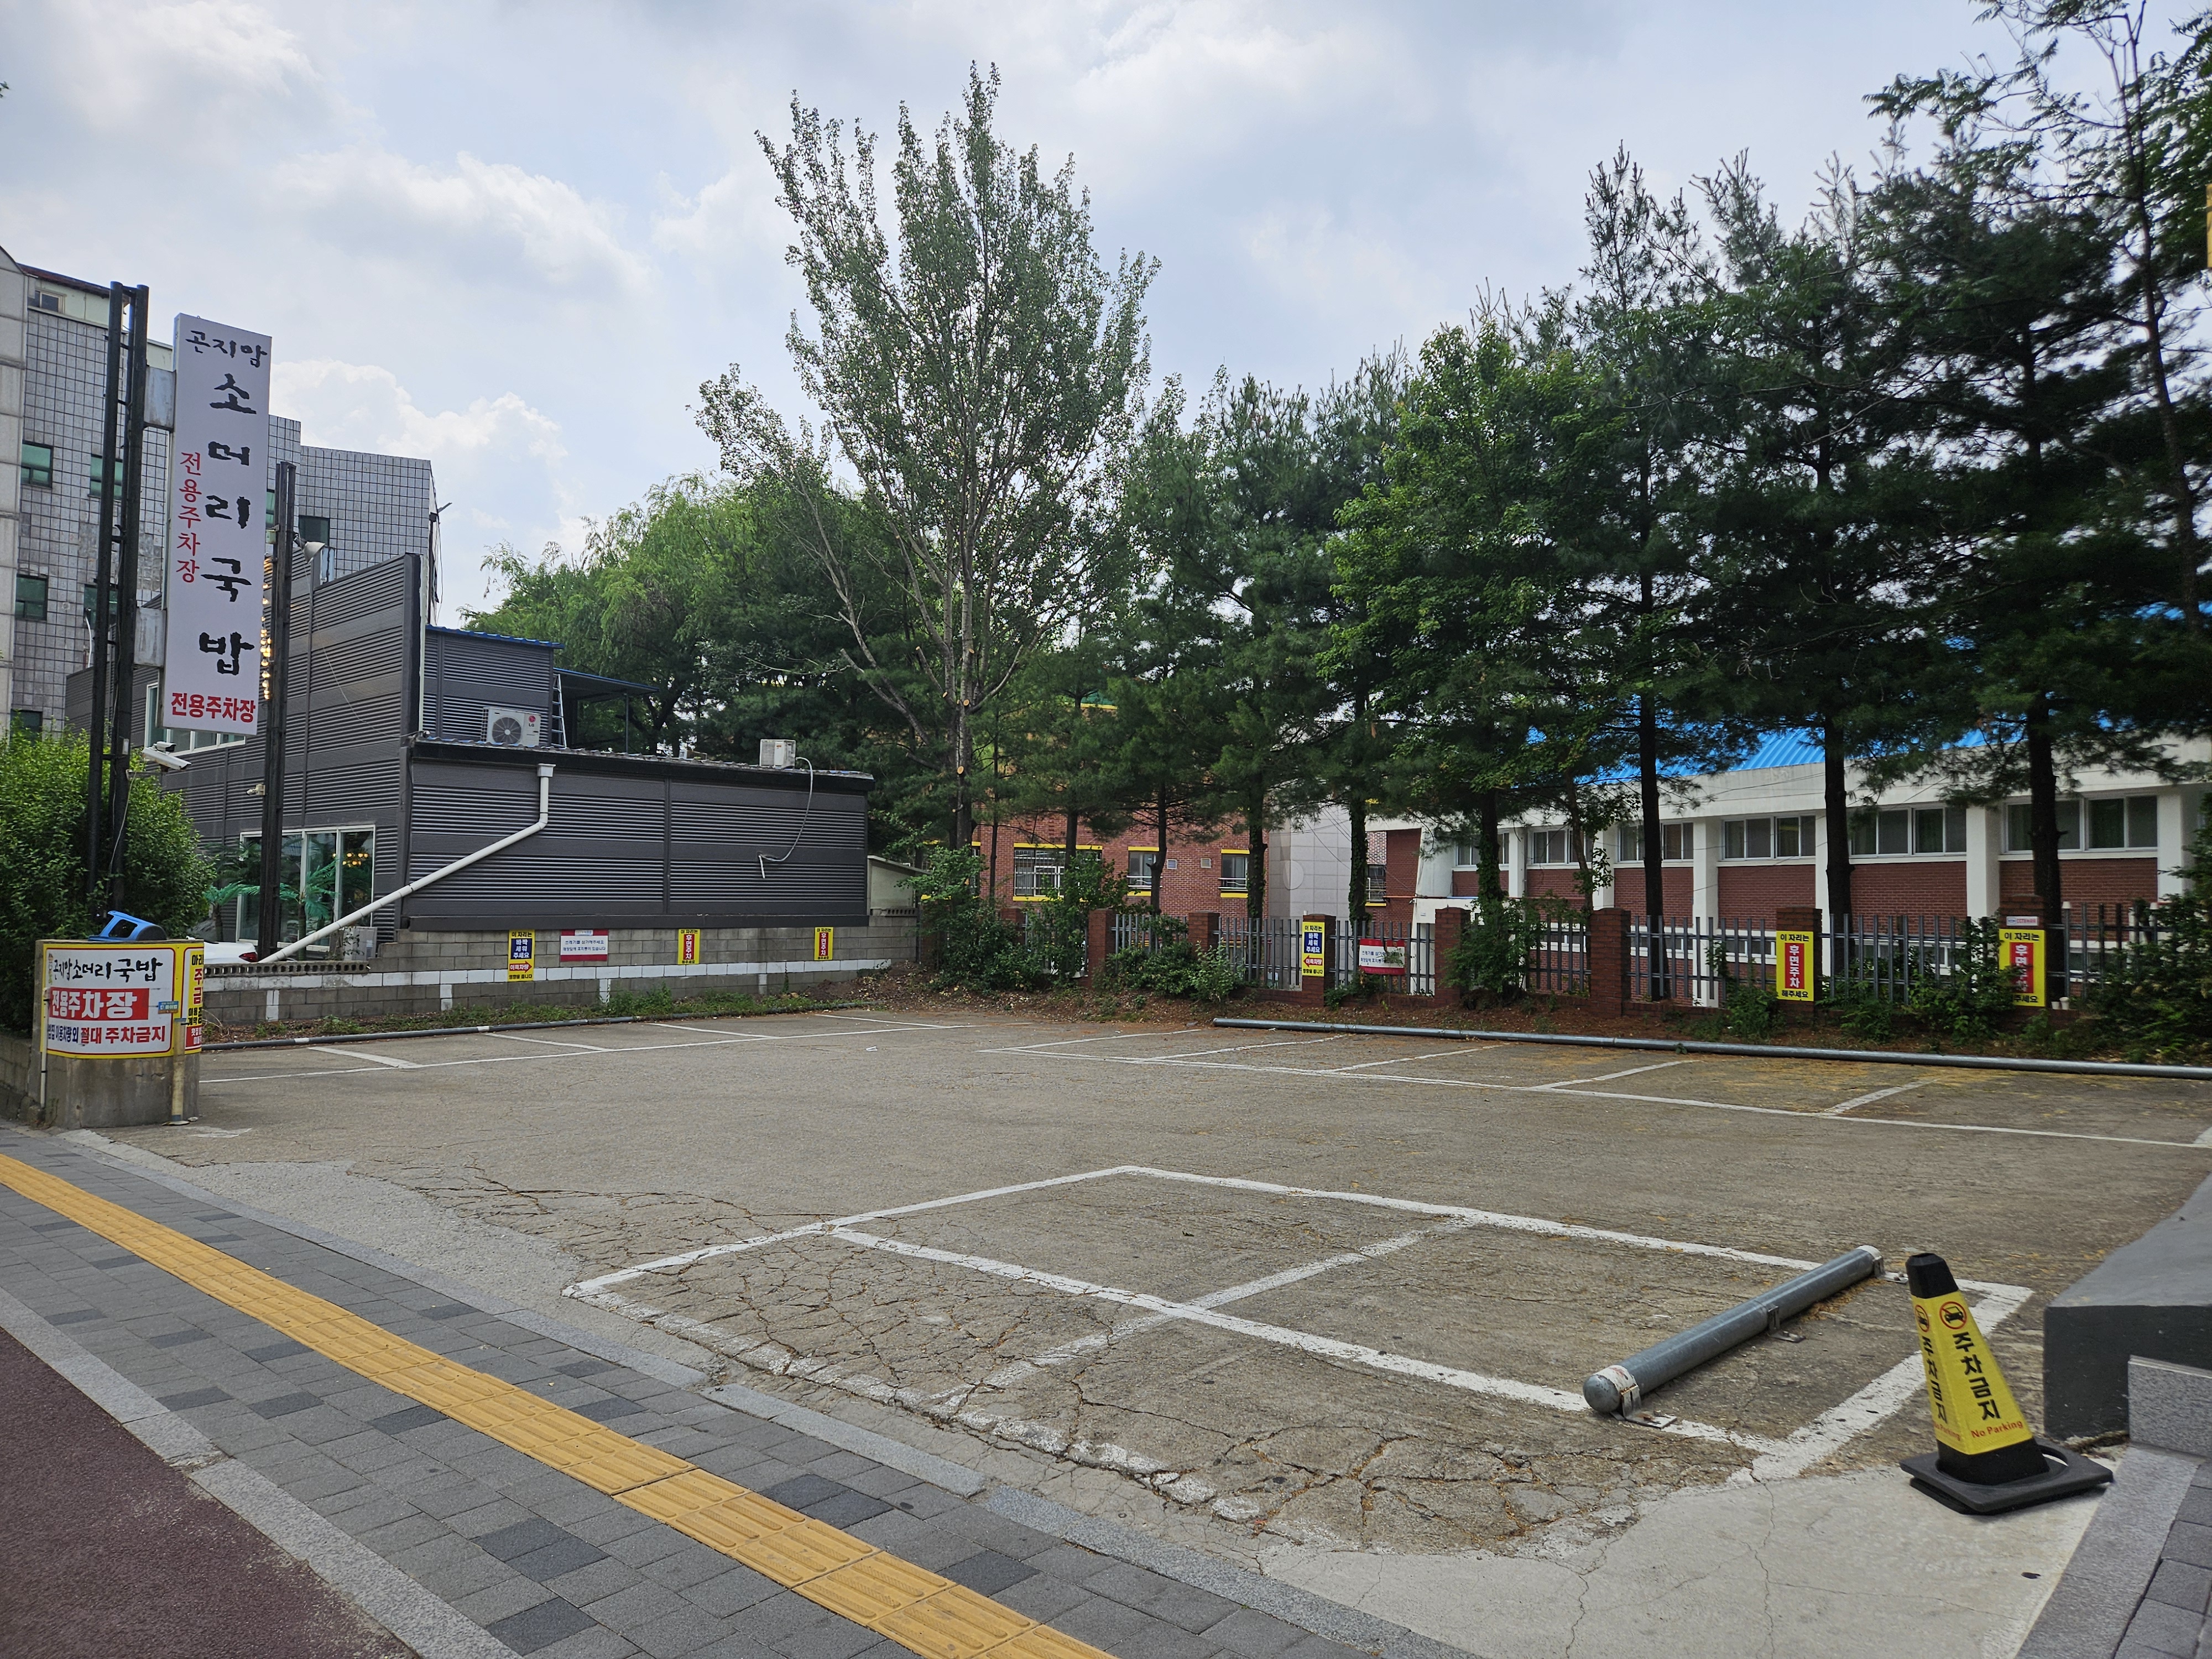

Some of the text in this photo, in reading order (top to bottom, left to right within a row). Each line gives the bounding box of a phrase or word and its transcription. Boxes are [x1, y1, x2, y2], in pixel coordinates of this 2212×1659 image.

[185, 330, 268, 368] 곤지암
[176, 451, 202, 584] 전용주차장
[199, 373, 257, 675] 소머리국밥
[171, 693, 256, 723] 전용주차장
[2015, 933, 2040, 941] 자리는
[1790, 945, 1800, 988] 후면주차
[52, 990, 137, 1019] 전용주차장
[1782, 990, 1808, 998] 해주세요
[81, 1027, 102, 1044] 절대
[105, 1025, 165, 1044] 주차금지
[1922, 1335, 1948, 1424] 주차금지
[1953, 1331, 2001, 1421] 주차금지
[1971, 1421, 2023, 1438] No Parking
